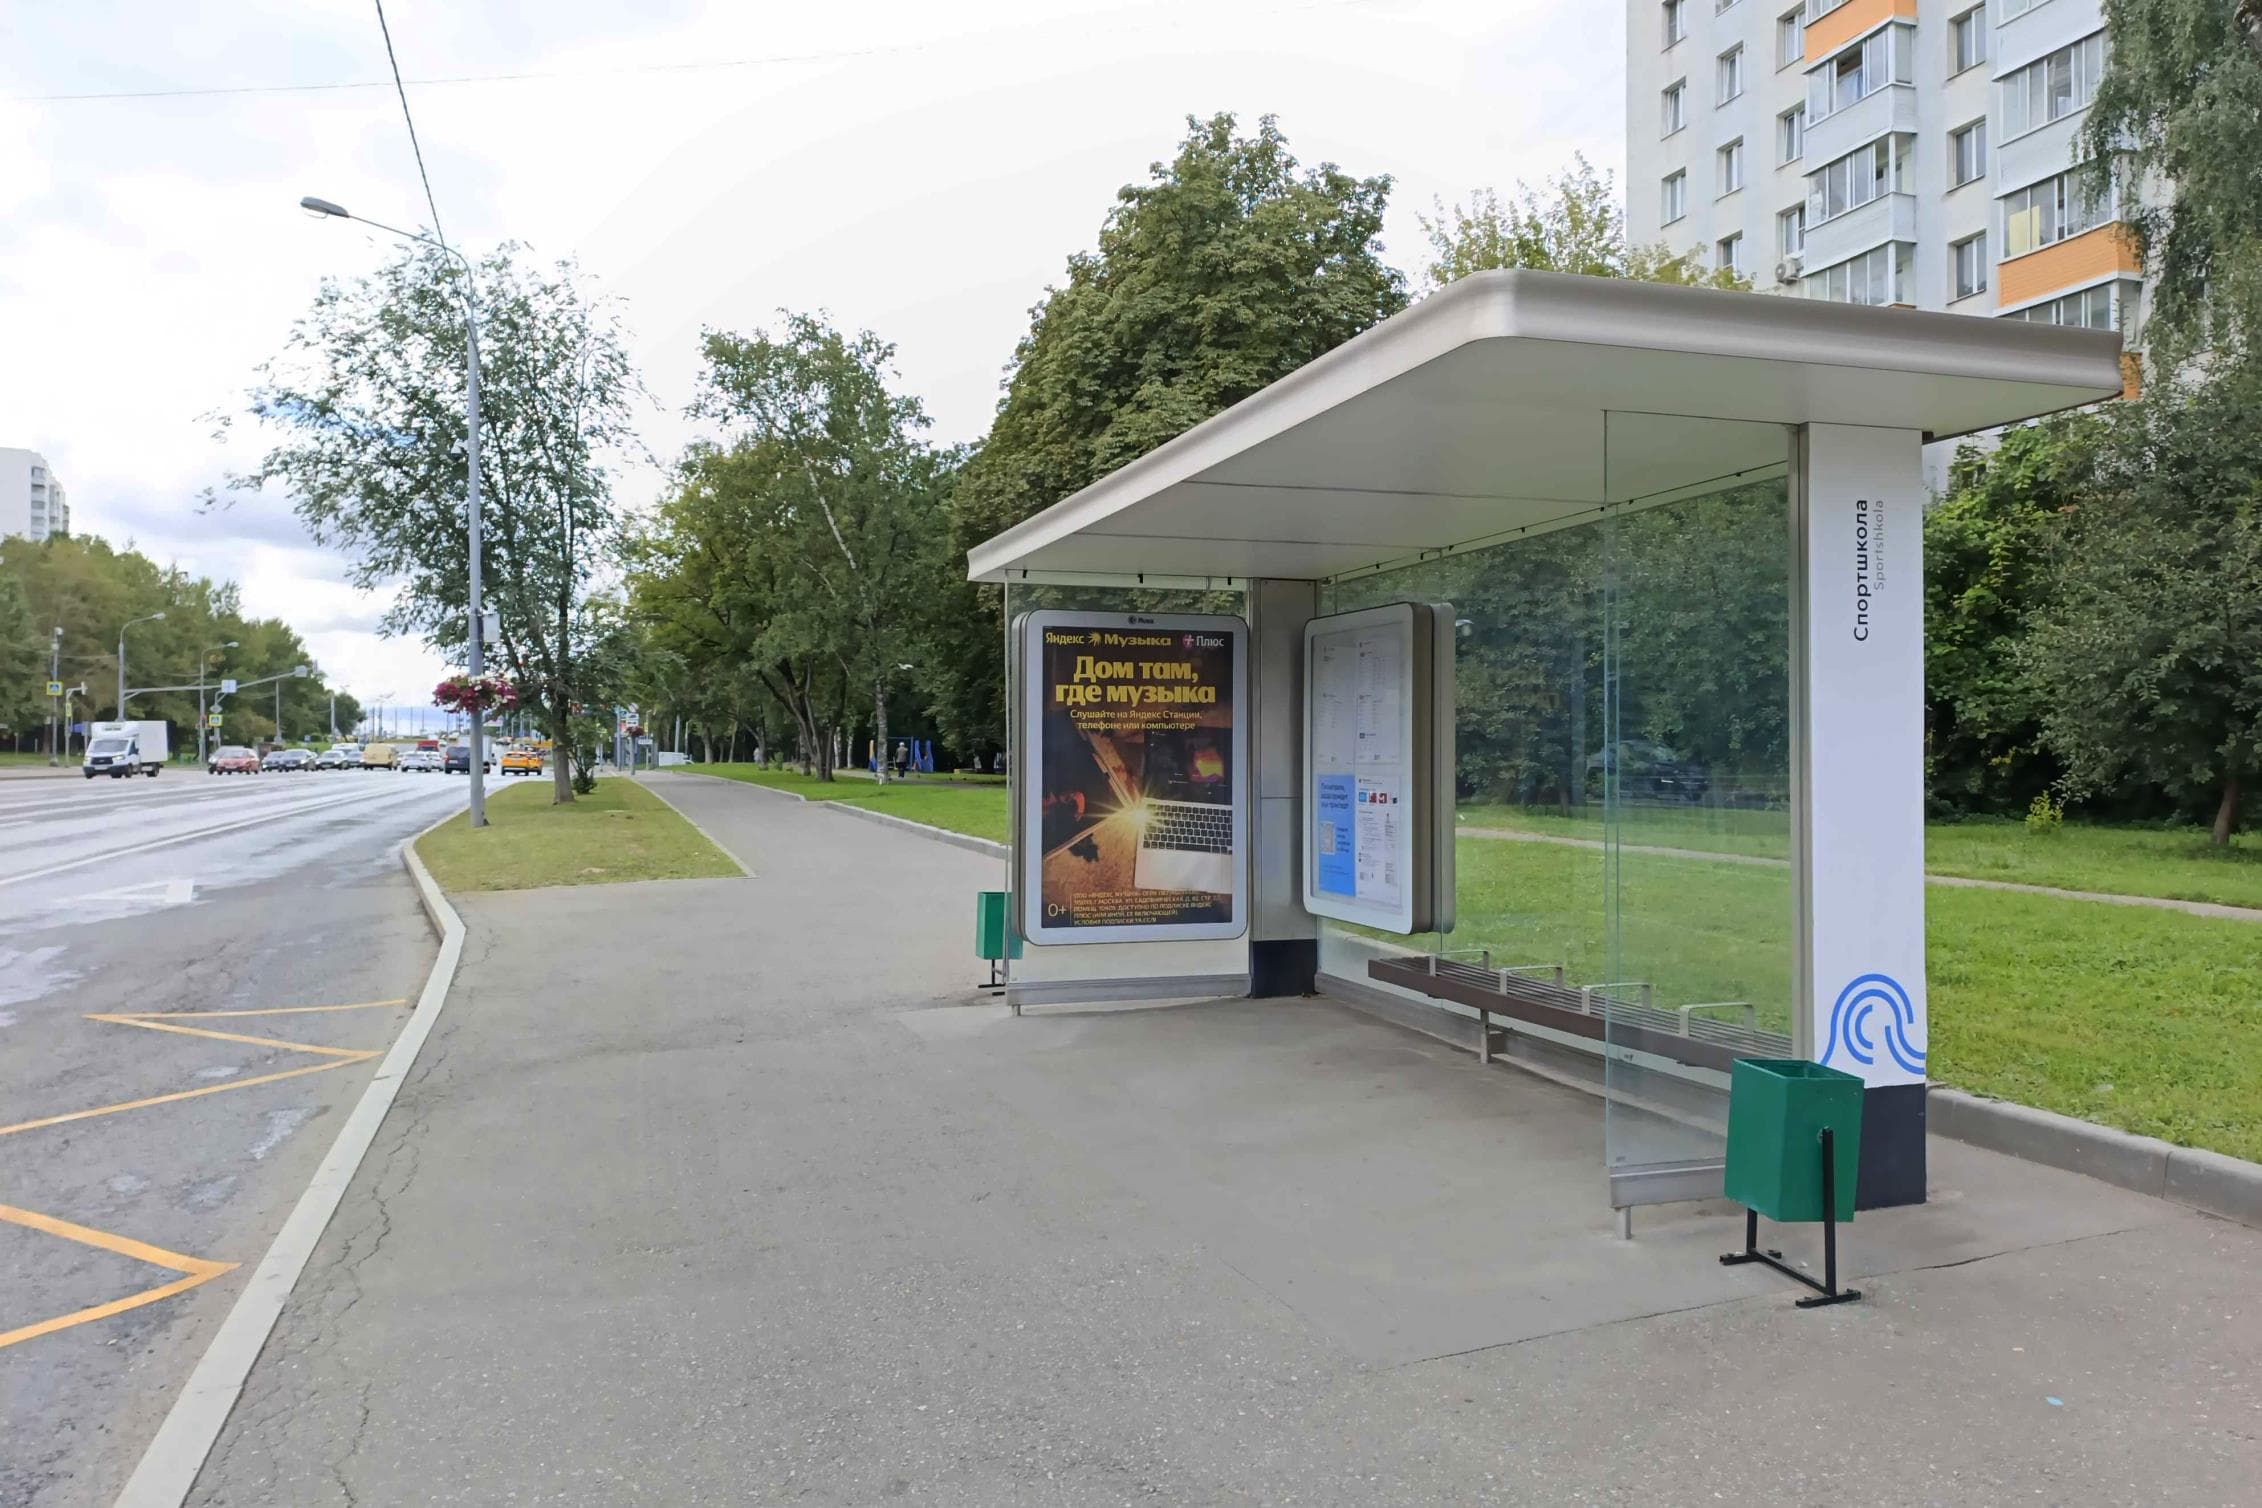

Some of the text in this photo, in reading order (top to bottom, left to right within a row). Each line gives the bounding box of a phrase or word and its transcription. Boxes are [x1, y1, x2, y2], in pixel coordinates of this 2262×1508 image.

[1873, 500, 1887, 590] Sportshkola
[1853, 499, 1872, 642] Спортшкола
[1046, 632, 1172, 648] Яндекс Музыка
[1196, 635, 1225, 647] Плюс
[1073, 655, 1199, 683] Дом там,
[1055, 684, 1216, 707] где музыка
[1070, 709, 1115, 720] Слушайте
[1117, 711, 1128, 719] на
[1129, 710, 1161, 720] Яндекс
[1078, 720, 1121, 731] телефоне
[1141, 721, 1196, 732] компьютере
[1047, 903, 1067, 917] 0+
